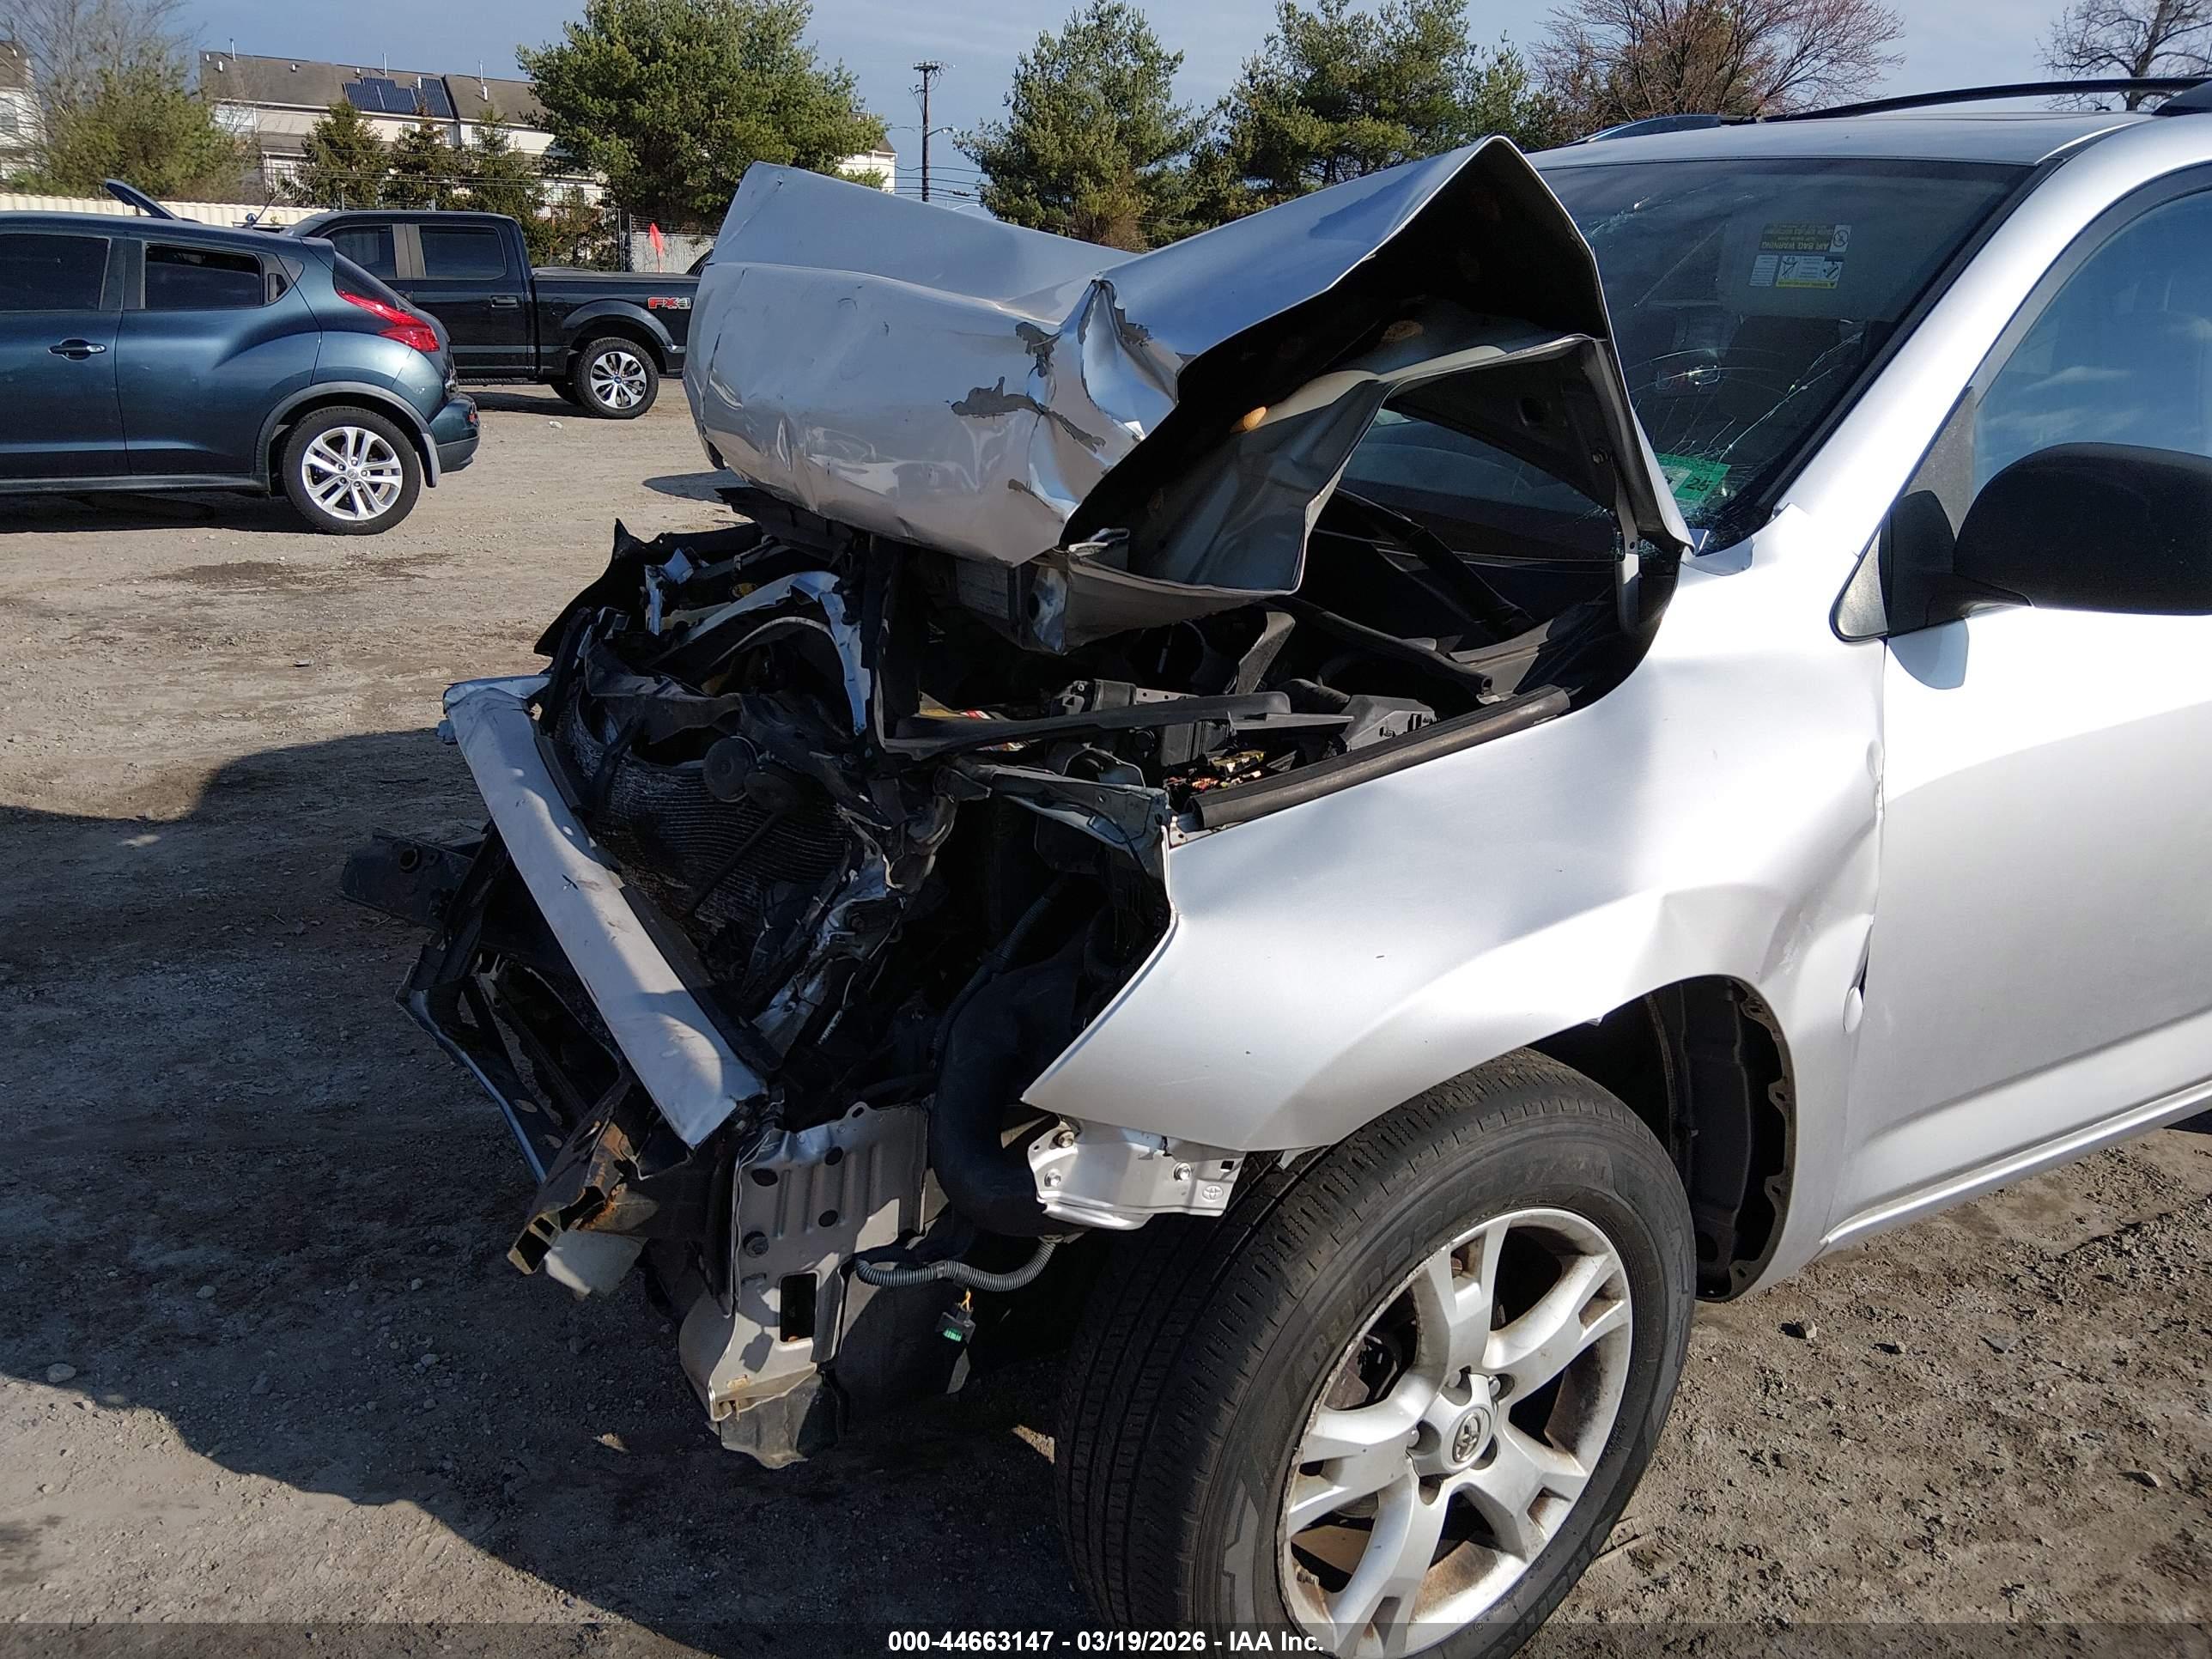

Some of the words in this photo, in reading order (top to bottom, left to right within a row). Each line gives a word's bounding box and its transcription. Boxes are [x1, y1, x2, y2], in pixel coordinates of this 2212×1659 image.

[1797, 241, 1814, 250] BAG
[1815, 241, 1829, 250] AIR
[648, 297, 690, 309] FX4
